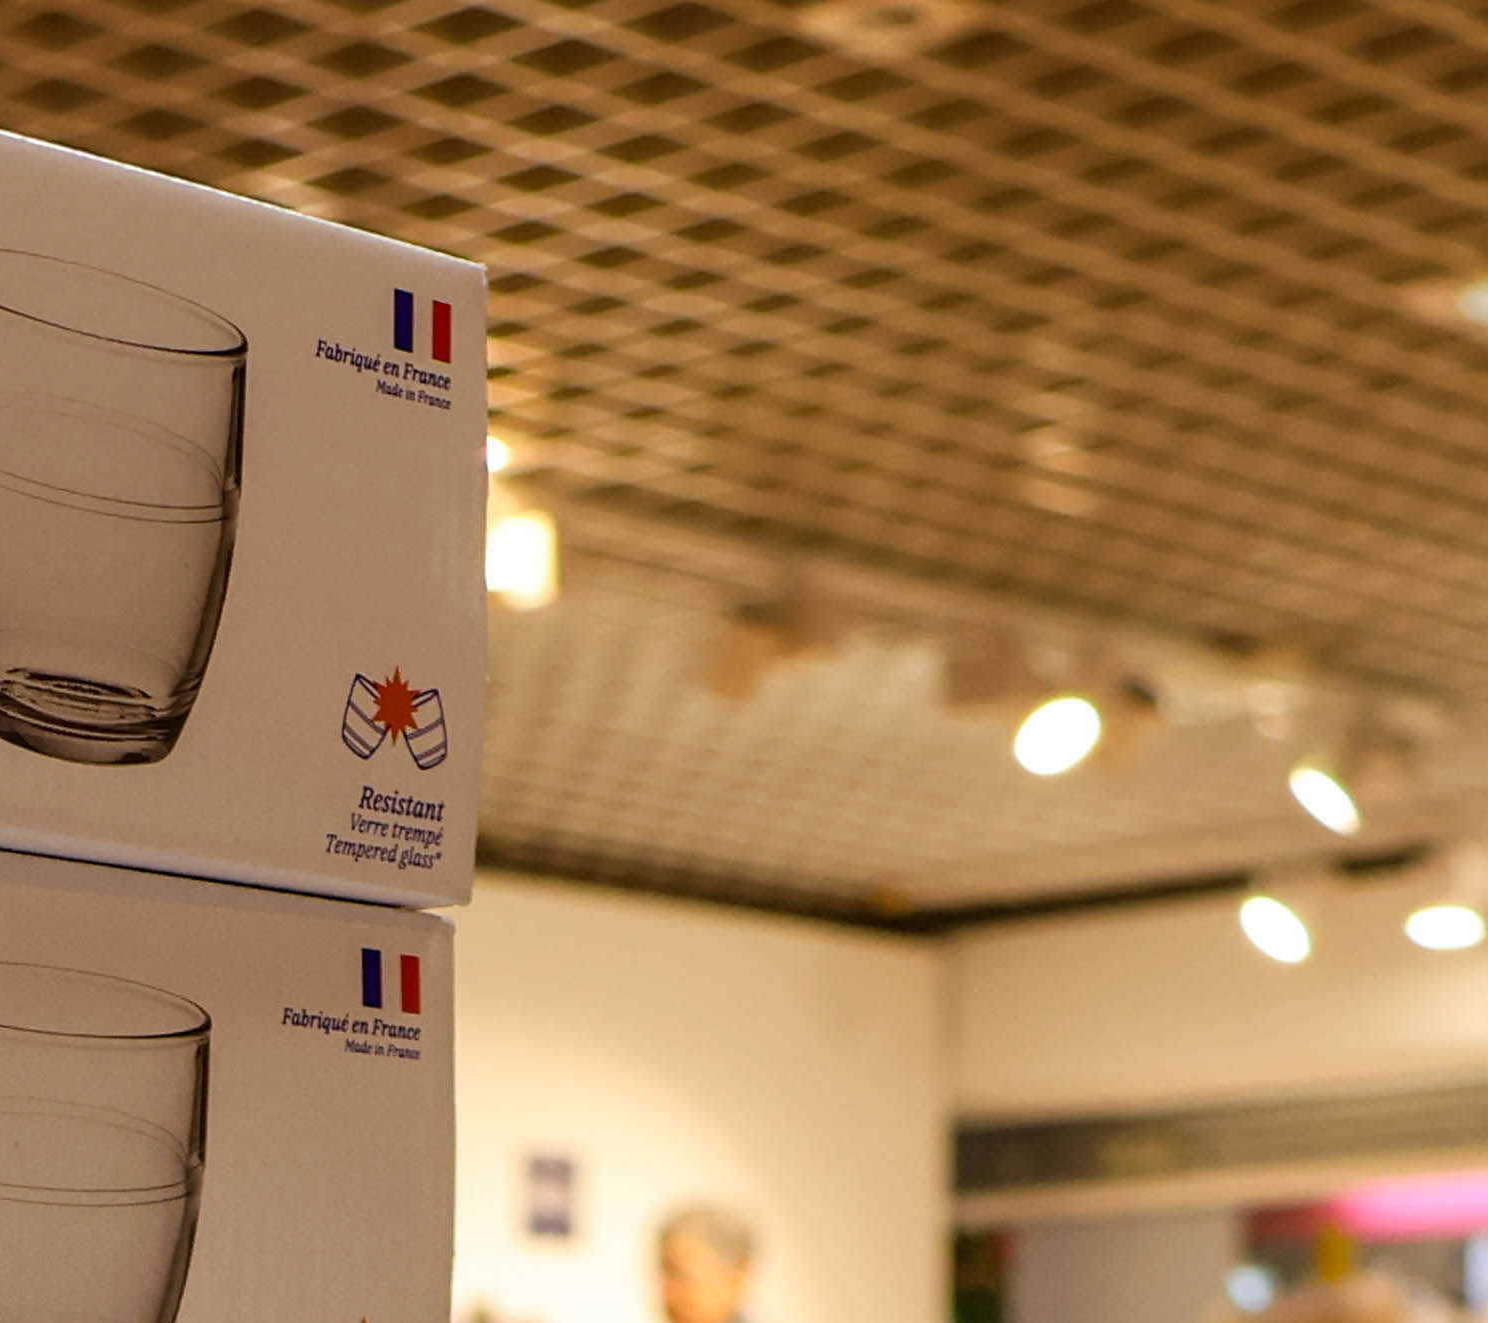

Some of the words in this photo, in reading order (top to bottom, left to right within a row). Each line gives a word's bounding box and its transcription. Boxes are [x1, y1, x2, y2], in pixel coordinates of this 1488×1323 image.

[316, 339, 381, 373] Fabriqué
[383, 360, 400, 377] en
[403, 362, 451, 390] France
[358, 786, 445, 821] Resistant
[326, 834, 398, 862] Tempered
[350, 813, 388, 837] Verre
[392, 823, 443, 849] trempé
